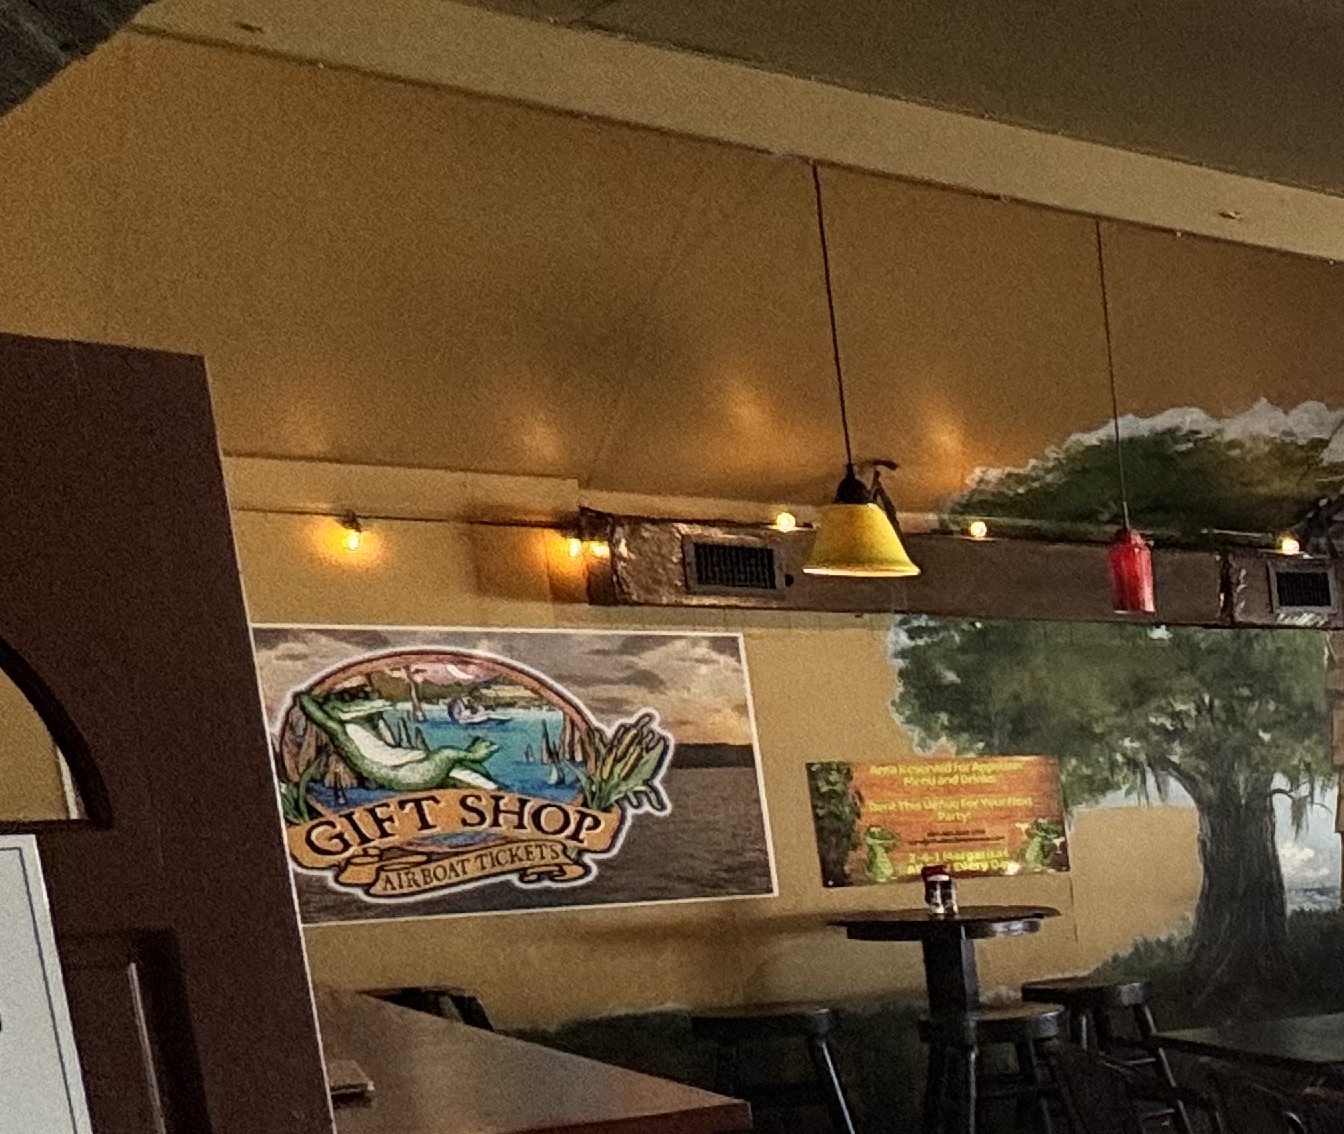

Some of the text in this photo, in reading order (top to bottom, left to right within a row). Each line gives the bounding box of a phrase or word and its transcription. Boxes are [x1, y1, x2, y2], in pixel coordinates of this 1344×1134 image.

[905, 773, 997, 787] Menu and Drinks
[305, 794, 605, 857] GIFT SHOP
[381, 844, 564, 892] AIRBOAT TICKETS
